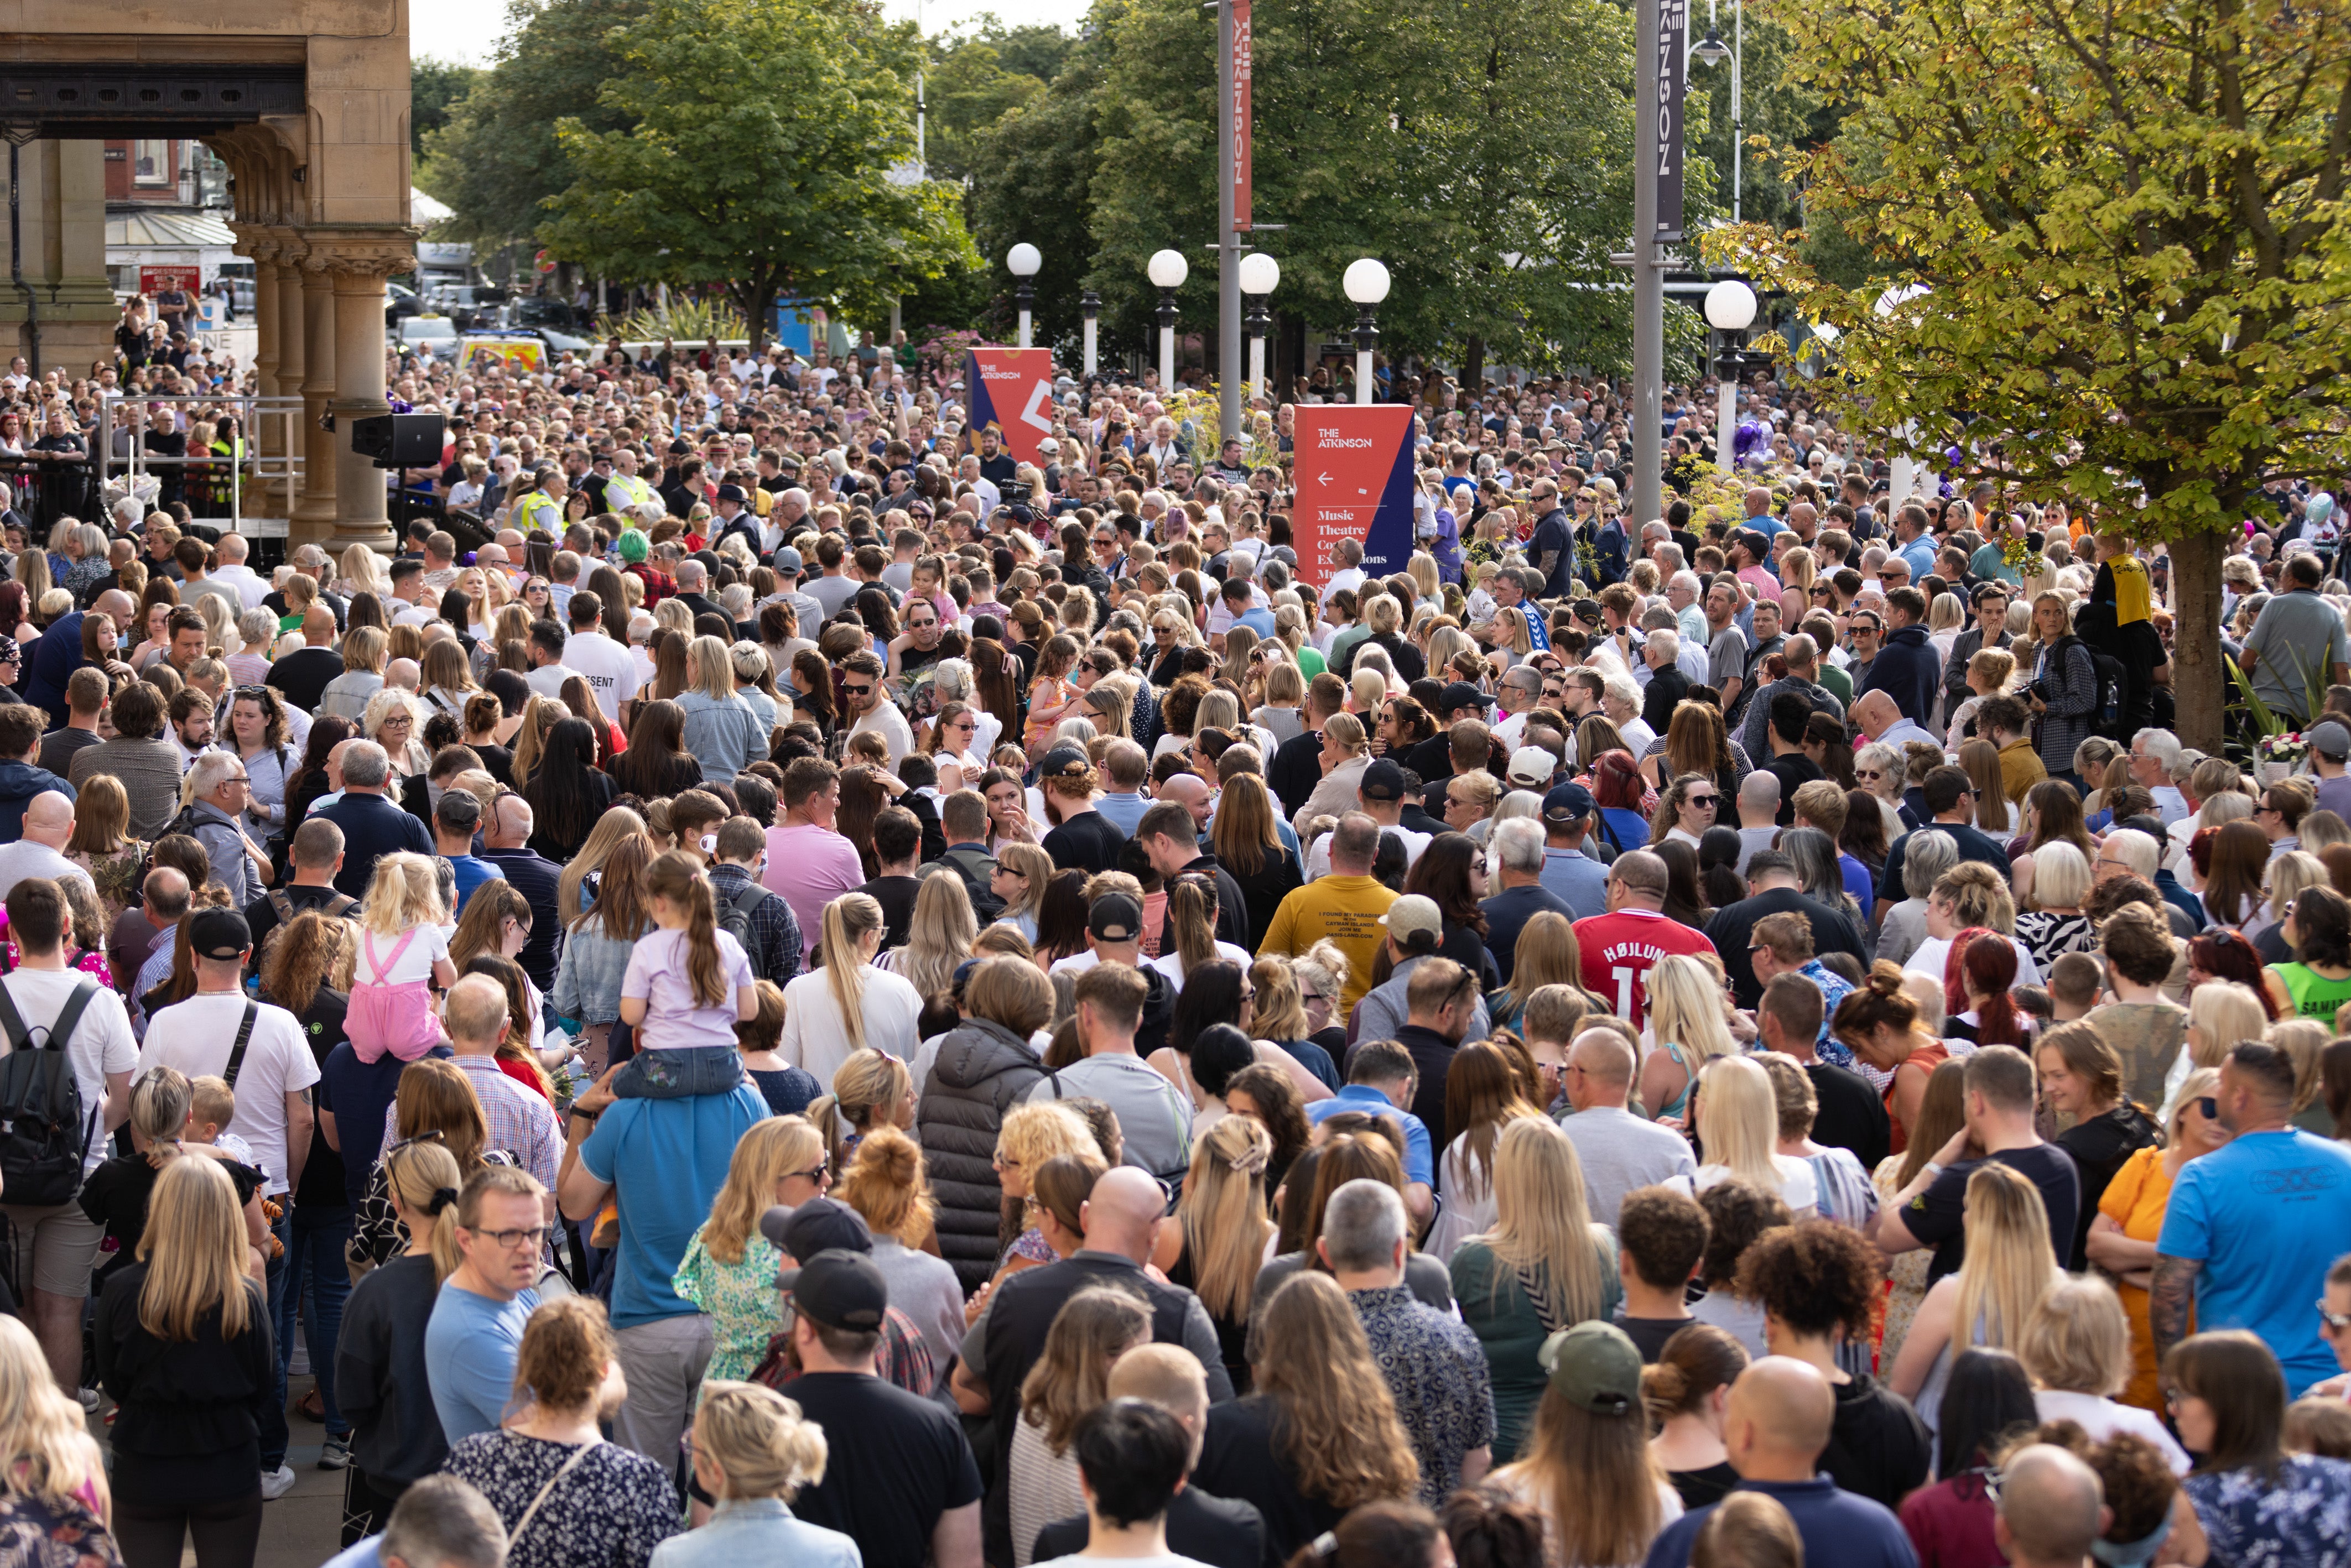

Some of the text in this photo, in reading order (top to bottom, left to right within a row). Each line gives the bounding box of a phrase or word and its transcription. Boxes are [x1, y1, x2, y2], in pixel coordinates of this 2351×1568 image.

[1242, 16, 1251, 80] THE
[1234, 17, 1243, 184] ATKINSON
[1318, 428, 1339, 437] THE
[1318, 438, 1372, 448] ATKINSON
[1317, 510, 1354, 520] Music
[1317, 525, 1365, 535] Theatre
[1603, 942, 1668, 963] HØJLUN
[235, 1020, 254, 1048] VLTN
